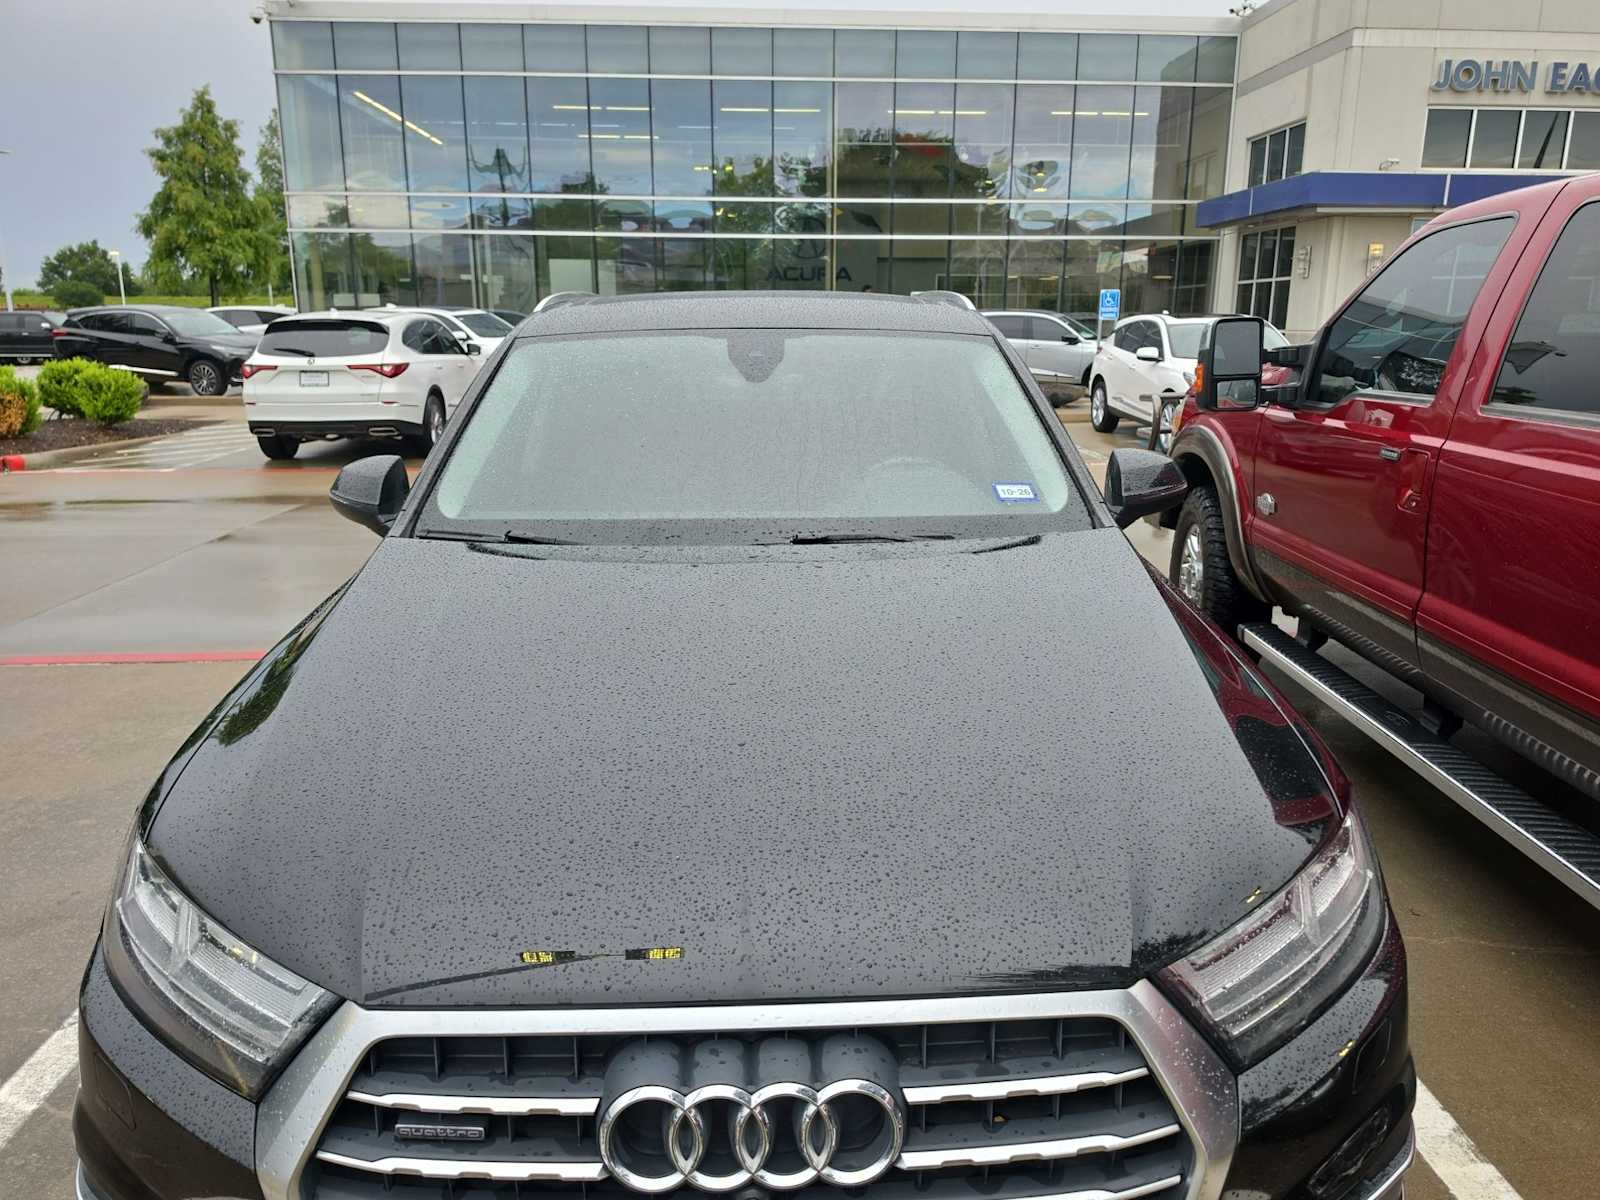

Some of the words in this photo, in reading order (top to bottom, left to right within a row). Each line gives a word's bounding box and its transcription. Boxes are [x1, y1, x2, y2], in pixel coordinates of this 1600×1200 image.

[1431, 59, 1539, 92] JOHN
[1548, 62, 1600, 93] EA
[399, 1127, 481, 1138] quattro
